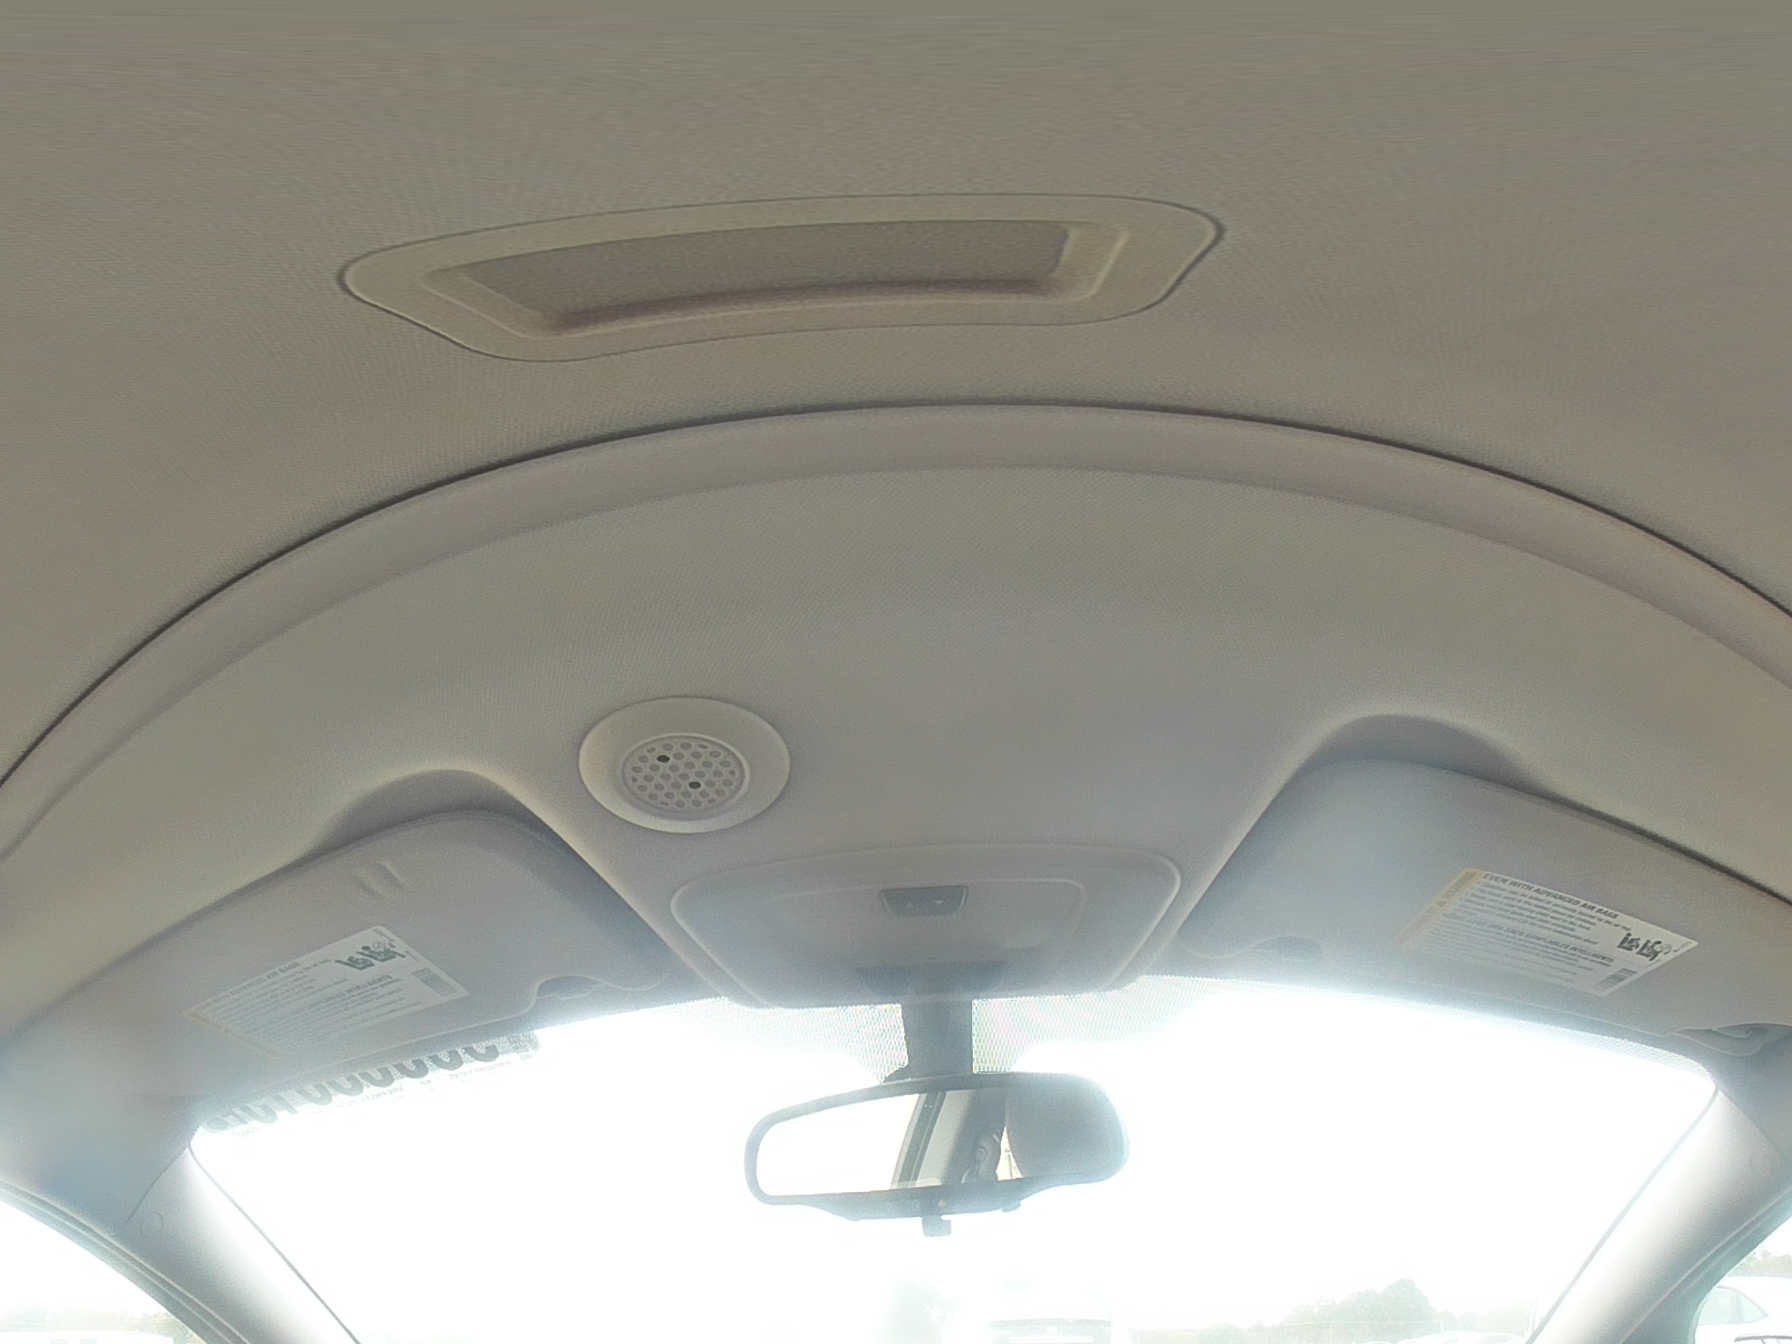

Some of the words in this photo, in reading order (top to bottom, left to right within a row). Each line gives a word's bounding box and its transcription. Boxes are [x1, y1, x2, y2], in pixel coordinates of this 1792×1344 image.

[1483, 873, 1508, 885] EVEN
[1510, 880, 1533, 892] WITH
[1533, 888, 1580, 905] ADVANCED
[1578, 902, 1596, 912] AIR
[1596, 908, 1620, 919] BAGS
